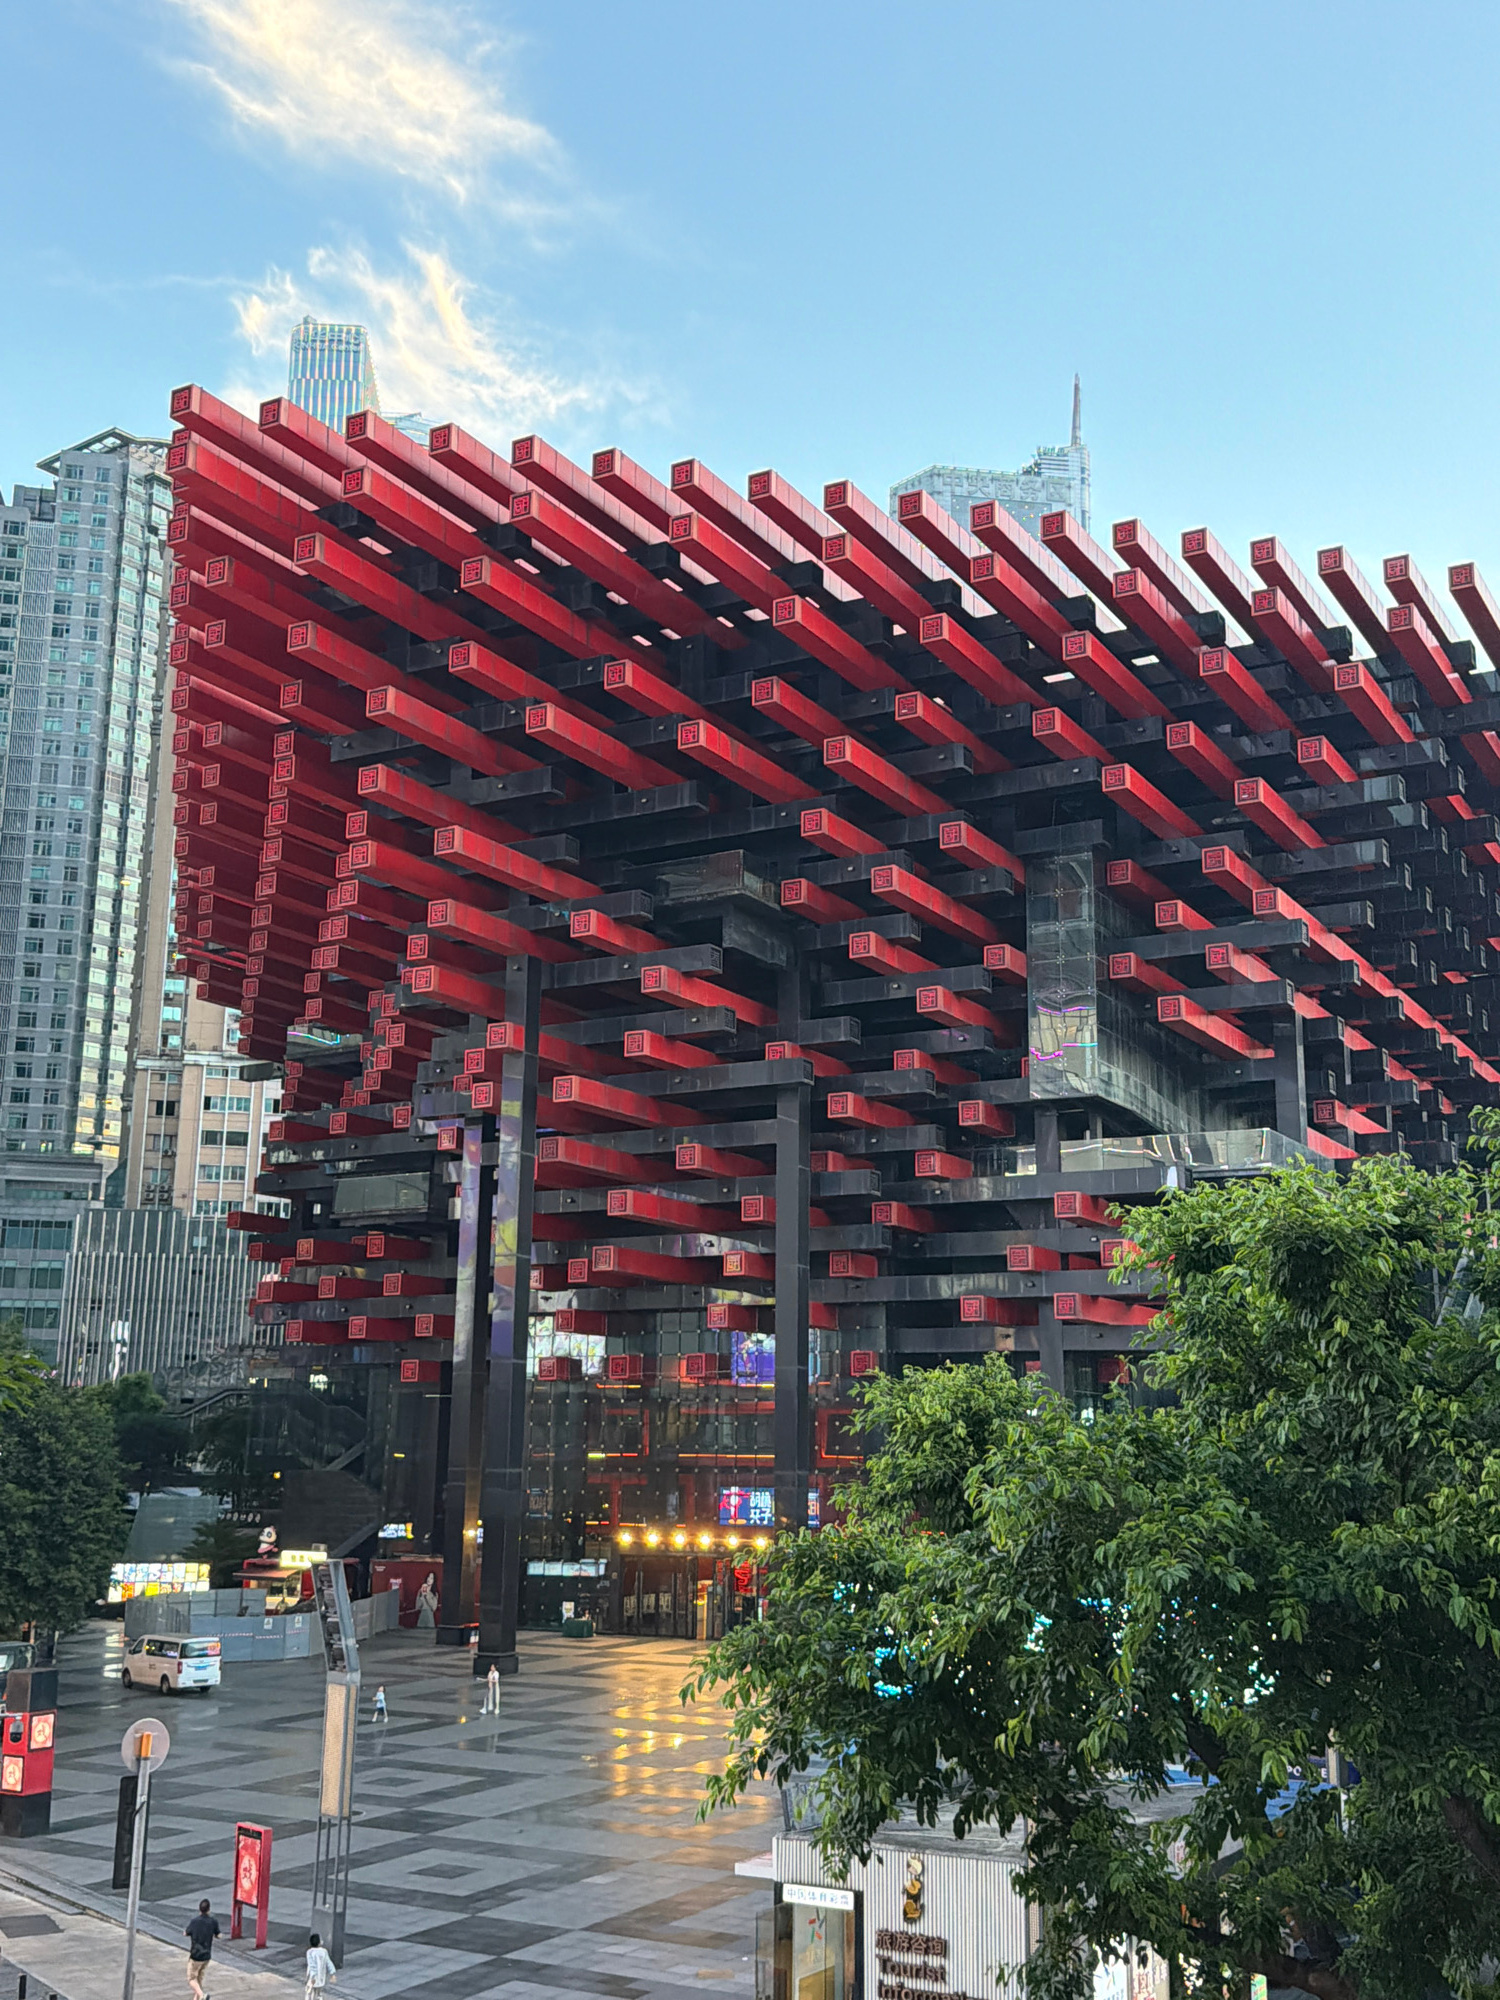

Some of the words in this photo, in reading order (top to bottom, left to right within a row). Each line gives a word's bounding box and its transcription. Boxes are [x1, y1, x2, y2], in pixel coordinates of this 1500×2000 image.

[942, 472, 1069, 503] 中央商务区
[876, 1930, 947, 1958] 旅游咨询
[876, 1954, 947, 1984] Tourist
